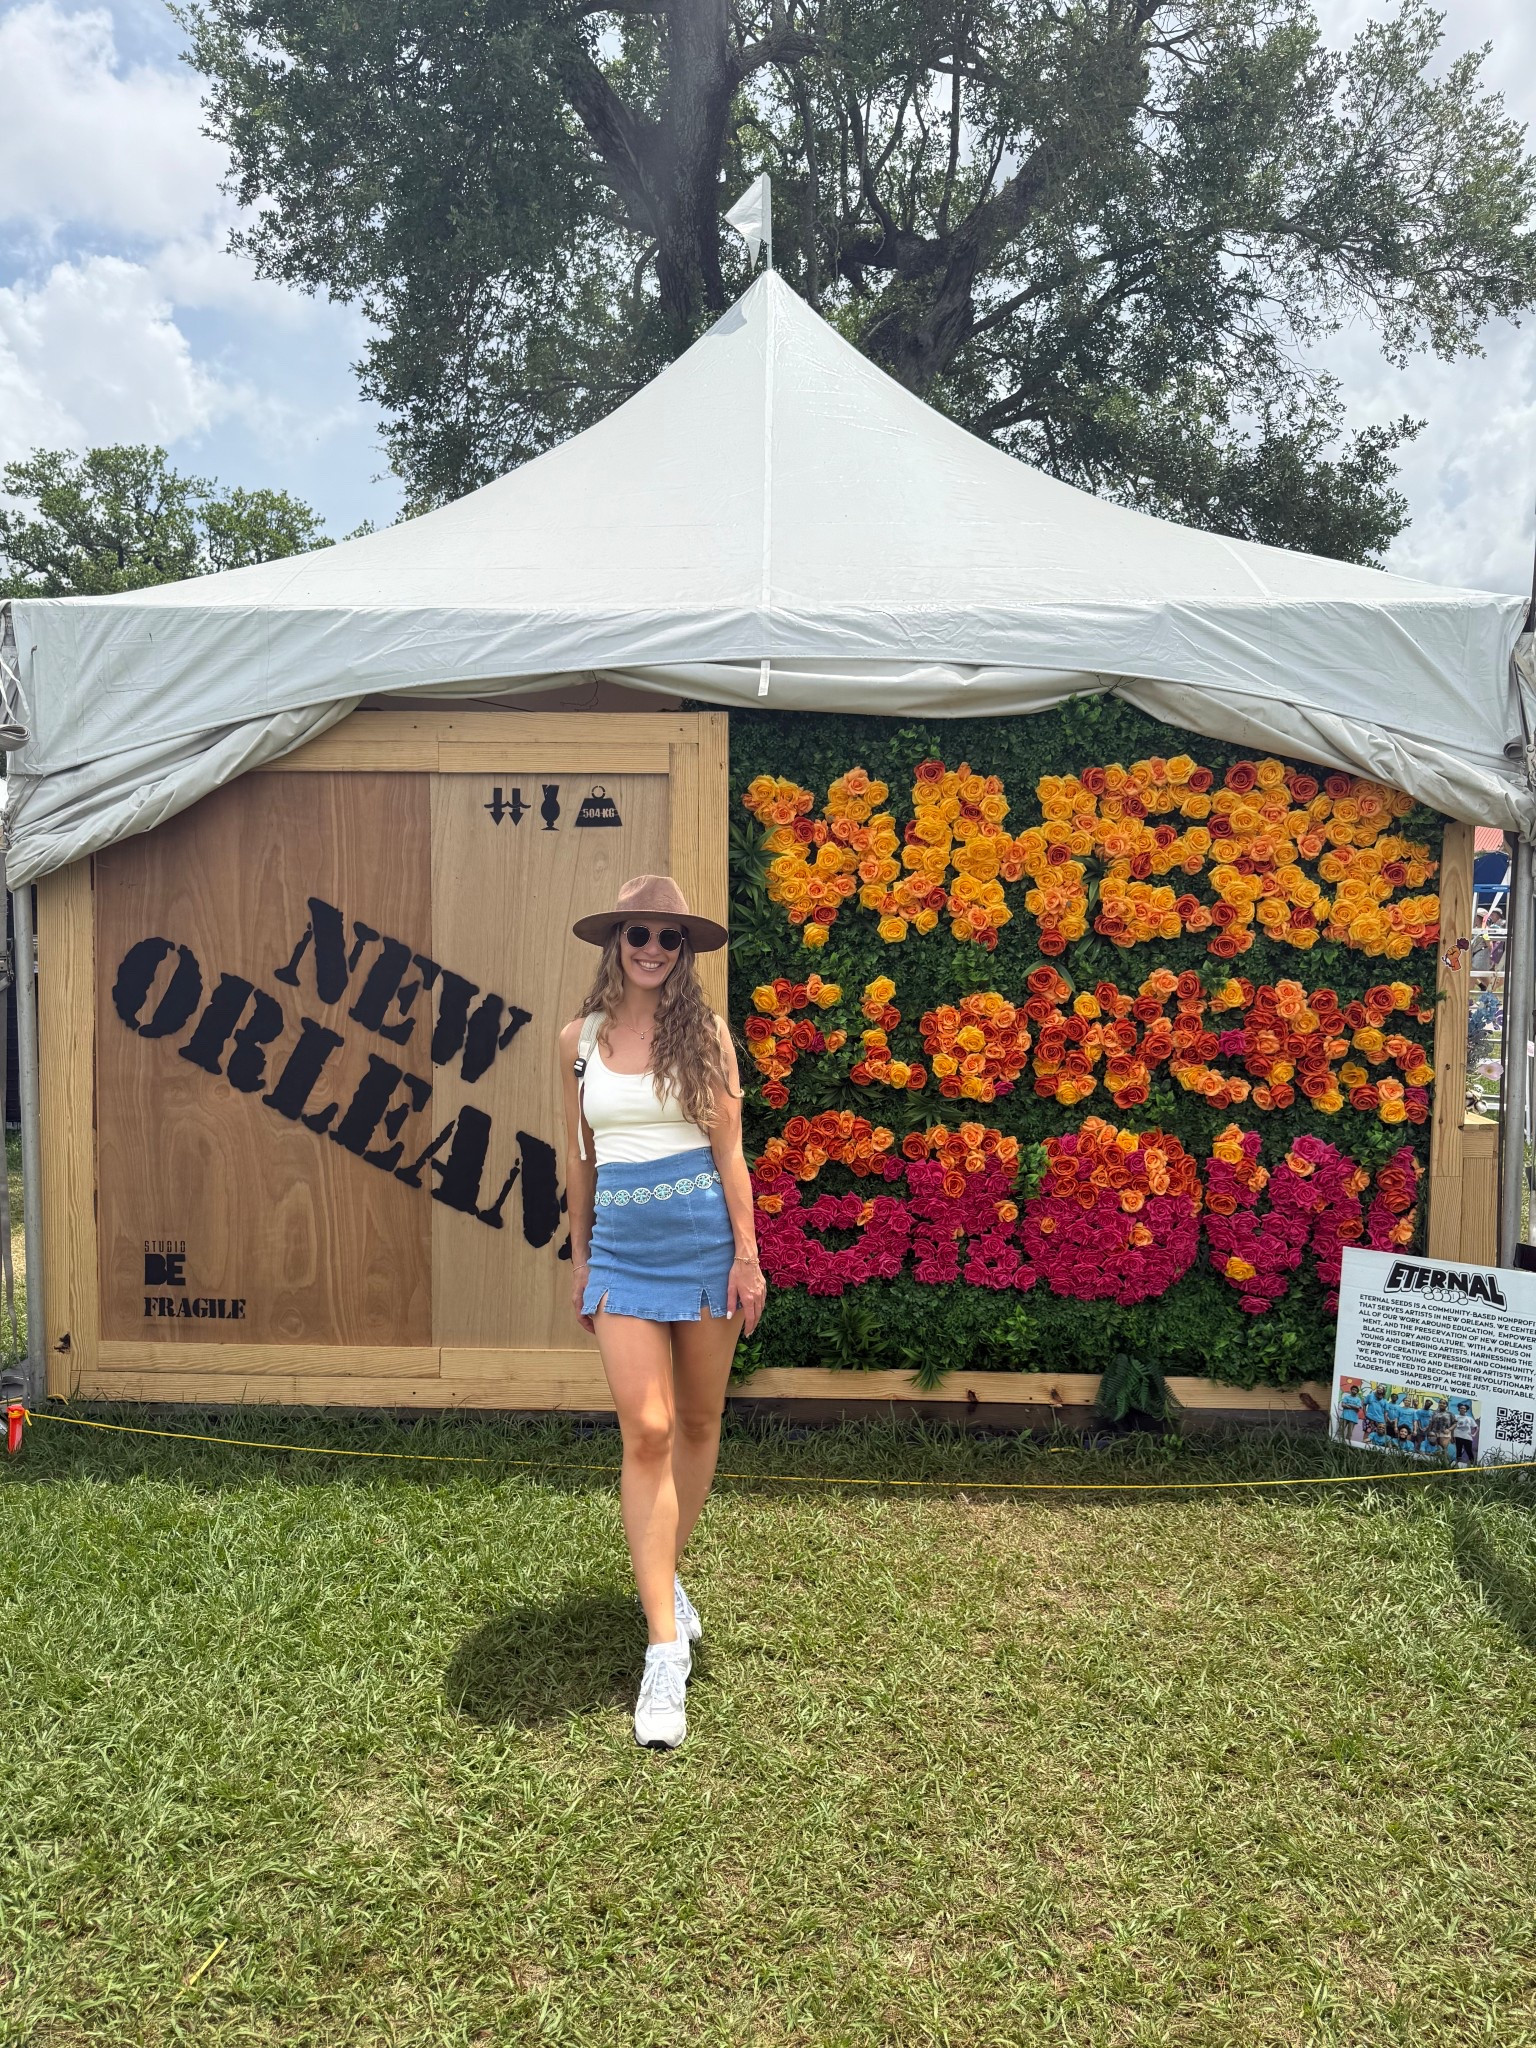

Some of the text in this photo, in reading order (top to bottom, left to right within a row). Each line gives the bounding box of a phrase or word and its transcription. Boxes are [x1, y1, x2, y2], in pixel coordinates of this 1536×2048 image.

[583, 808, 615, 818] 504 KG
[743, 756, 1440, 959] WHERE
[275, 897, 533, 1084] NEW
[745, 965, 1435, 1125] FLOWERS
[112, 936, 574, 1262] ORLEAN
[755, 1107, 1424, 1316] GROW
[145, 1241, 186, 1253] STUDIO
[145, 1254, 186, 1286] BE
[1384, 1260, 1507, 1312] ETERNAL
[144, 1297, 246, 1319] FRAGILE
[1360, 1294, 1389, 1303] ETERNAL
[1391, 1299, 1412, 1307] SEEDS
[1428, 1305, 1496, 1320] COMMUNITY-BASED
[1498, 1316, 1536, 1327] NONPROFI
[1378, 1305, 1403, 1313] SERVES
[1405, 1310, 1432, 1318] ARTISTS
[1461, 1318, 1495, 1328] ORLEANS.
[1363, 1325, 1384, 1333] BLACK
[1386, 1329, 1415, 1338] HISTORY
[1467, 1343, 1486, 1351] WITH
[1494, 1347, 1518, 1356] FOCUS
[1415, 1325, 1467, 1339] PRESERVATION
[1480, 1337, 1497, 1345] NEW
[1499, 1340, 1532, 1350] ORLEANS
[1421, 1320, 1451, 1328] AROUND
[1453, 1324, 1495, 1337] EDUCATION,
[1356, 1339, 1381, 1348] POWER
[1393, 1346, 1427, 1356] CREATIVE
[1429, 1352, 1472, 1364] EXPRESSION
[1490, 1363, 1536, 1376] COMMUNITY,
[1360, 1332, 1384, 1341] YOUNG
[1402, 1340, 1438, 1351] EMERGING
[1471, 1351, 1517, 1363] HARNESSING
[1354, 1362, 1383, 1372] LEADERS
[1400, 1370, 1431, 1380] SHAPERS
[1451, 1380, 1471, 1388] MORE
[1472, 1383, 1491, 1392] JUST,
[1493, 1387, 1536, 1400] EQUITABLE,
[1356, 1354, 1377, 1362] TOOLS
[1427, 1367, 1456, 1377] BECOME
[1474, 1375, 1534, 1390] REVOLUTIONARY
[1371, 1350, 1400, 1359] PROVIDE
[1402, 1355, 1426, 1364] YOUNG
[1444, 1363, 1481, 1373] EMERGING
[1482, 1370, 1512, 1379] ARTISTS
[1514, 1374, 1532, 1382] WITH
[1422, 1383, 1448, 1391] ARTFUL
[1450, 1387, 1477, 1397] WORLD.
